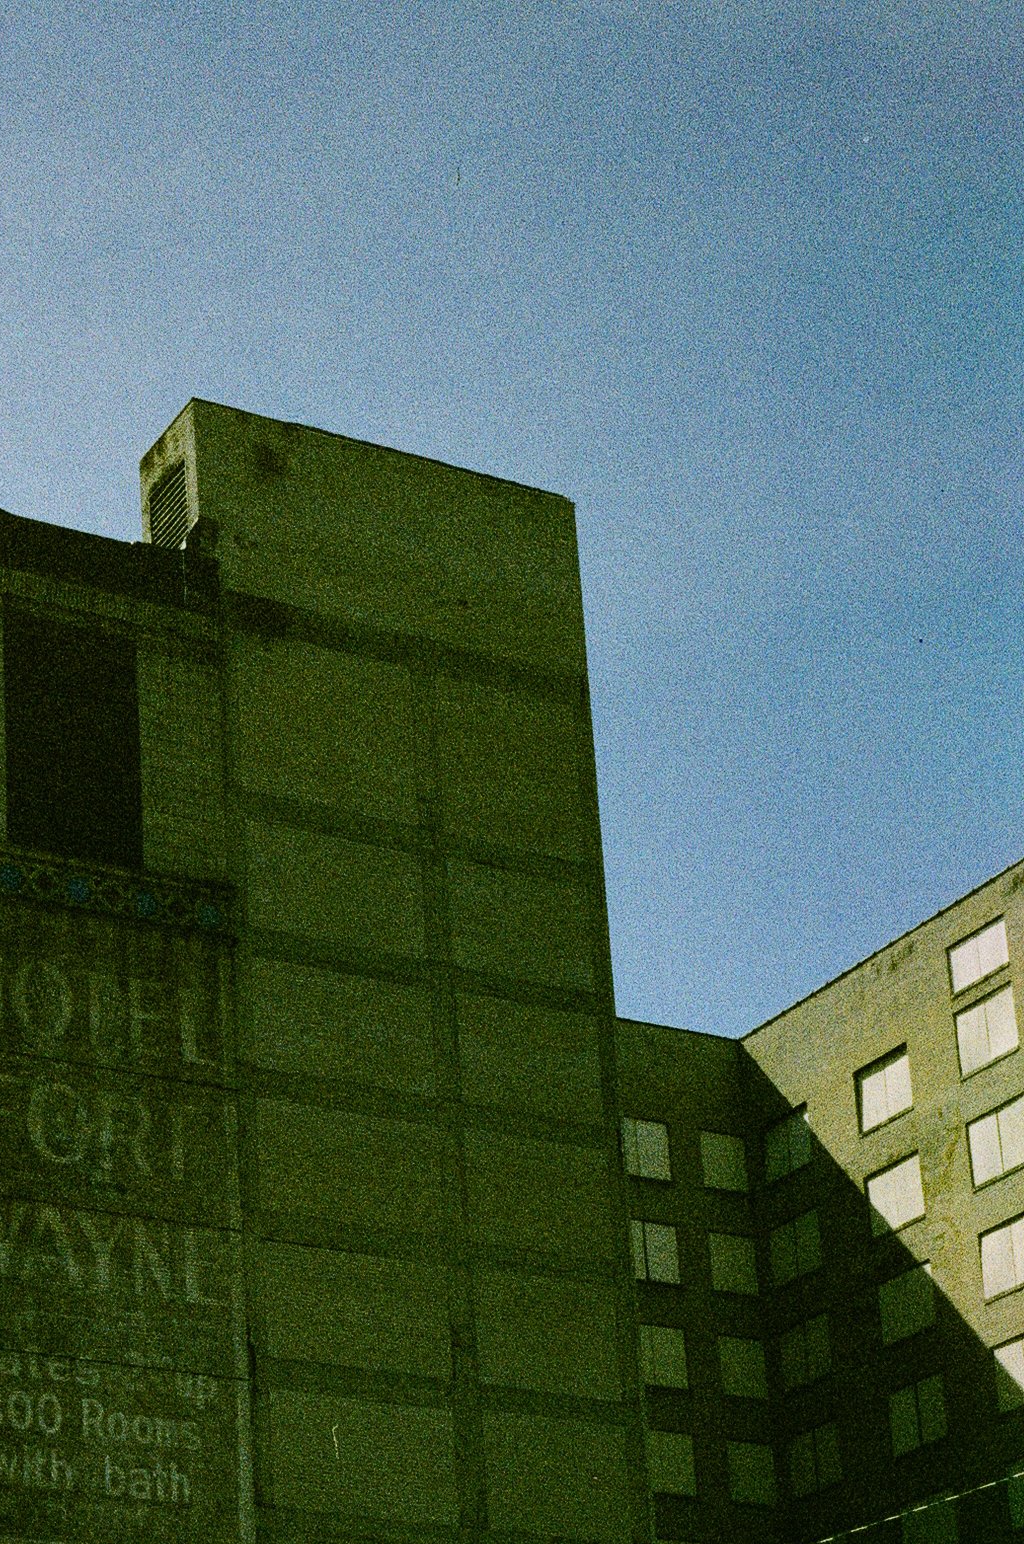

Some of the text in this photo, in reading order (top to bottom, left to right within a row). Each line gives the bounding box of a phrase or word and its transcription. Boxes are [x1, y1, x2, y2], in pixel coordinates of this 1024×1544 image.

[175, 1370, 218, 1411] up
[80, 1396, 204, 1451] Rooms
[103, 1454, 192, 1504] bath
